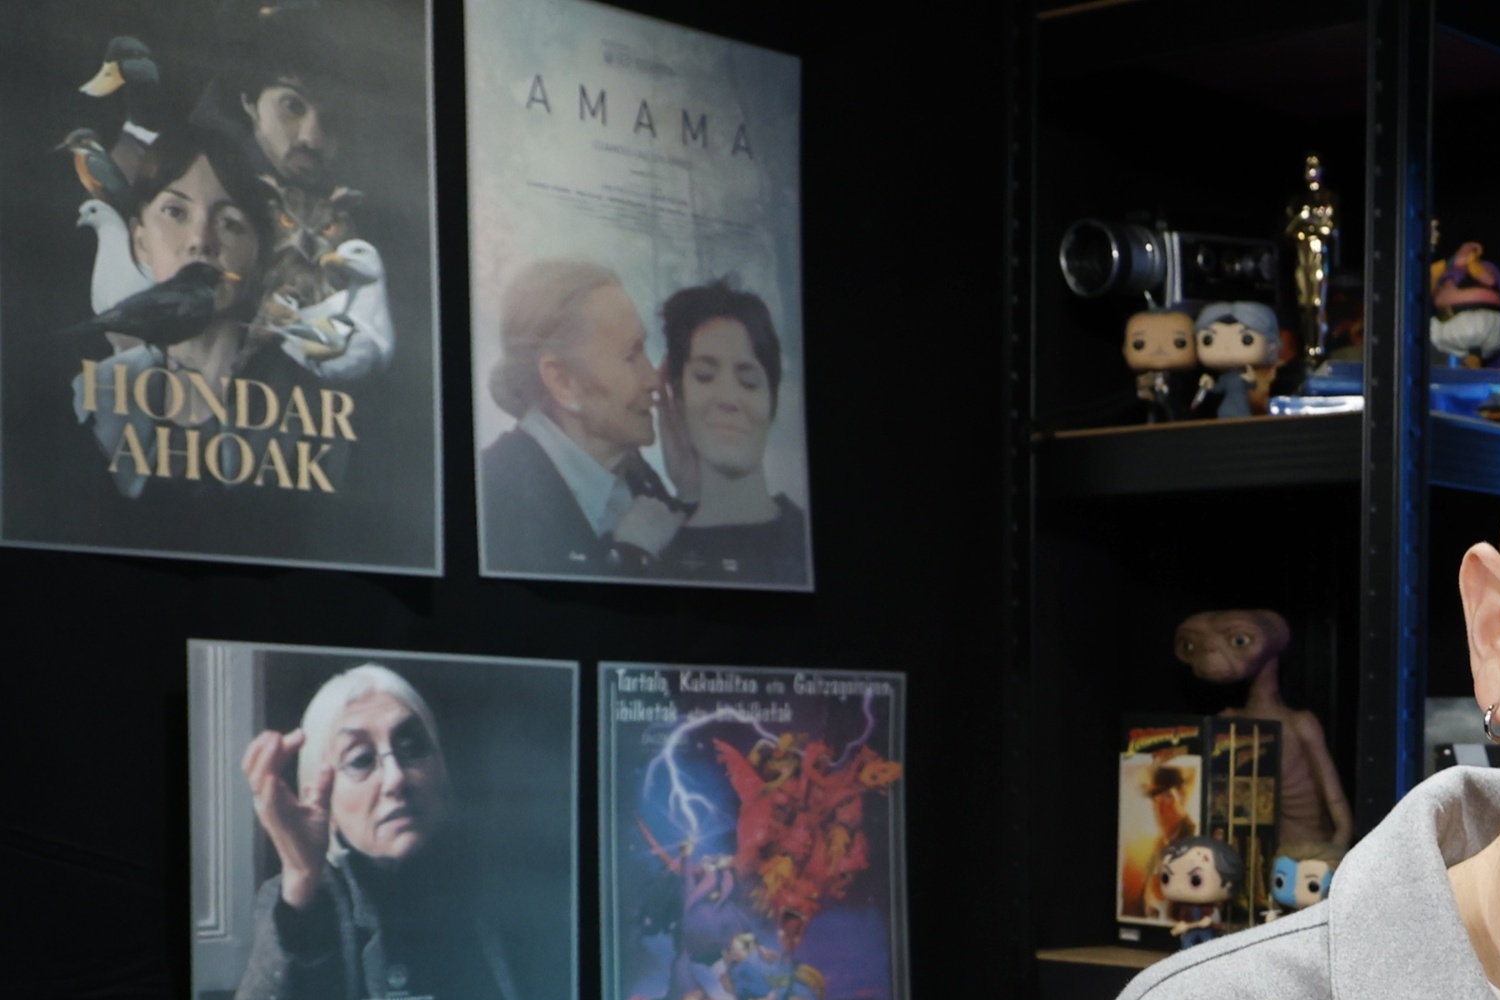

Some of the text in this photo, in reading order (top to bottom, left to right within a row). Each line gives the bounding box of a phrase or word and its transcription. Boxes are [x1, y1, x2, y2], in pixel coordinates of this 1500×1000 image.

[526, 73, 753, 160] AMAMA
[81, 358, 357, 441] HONDAR
[108, 422, 335, 493] AHOAK
